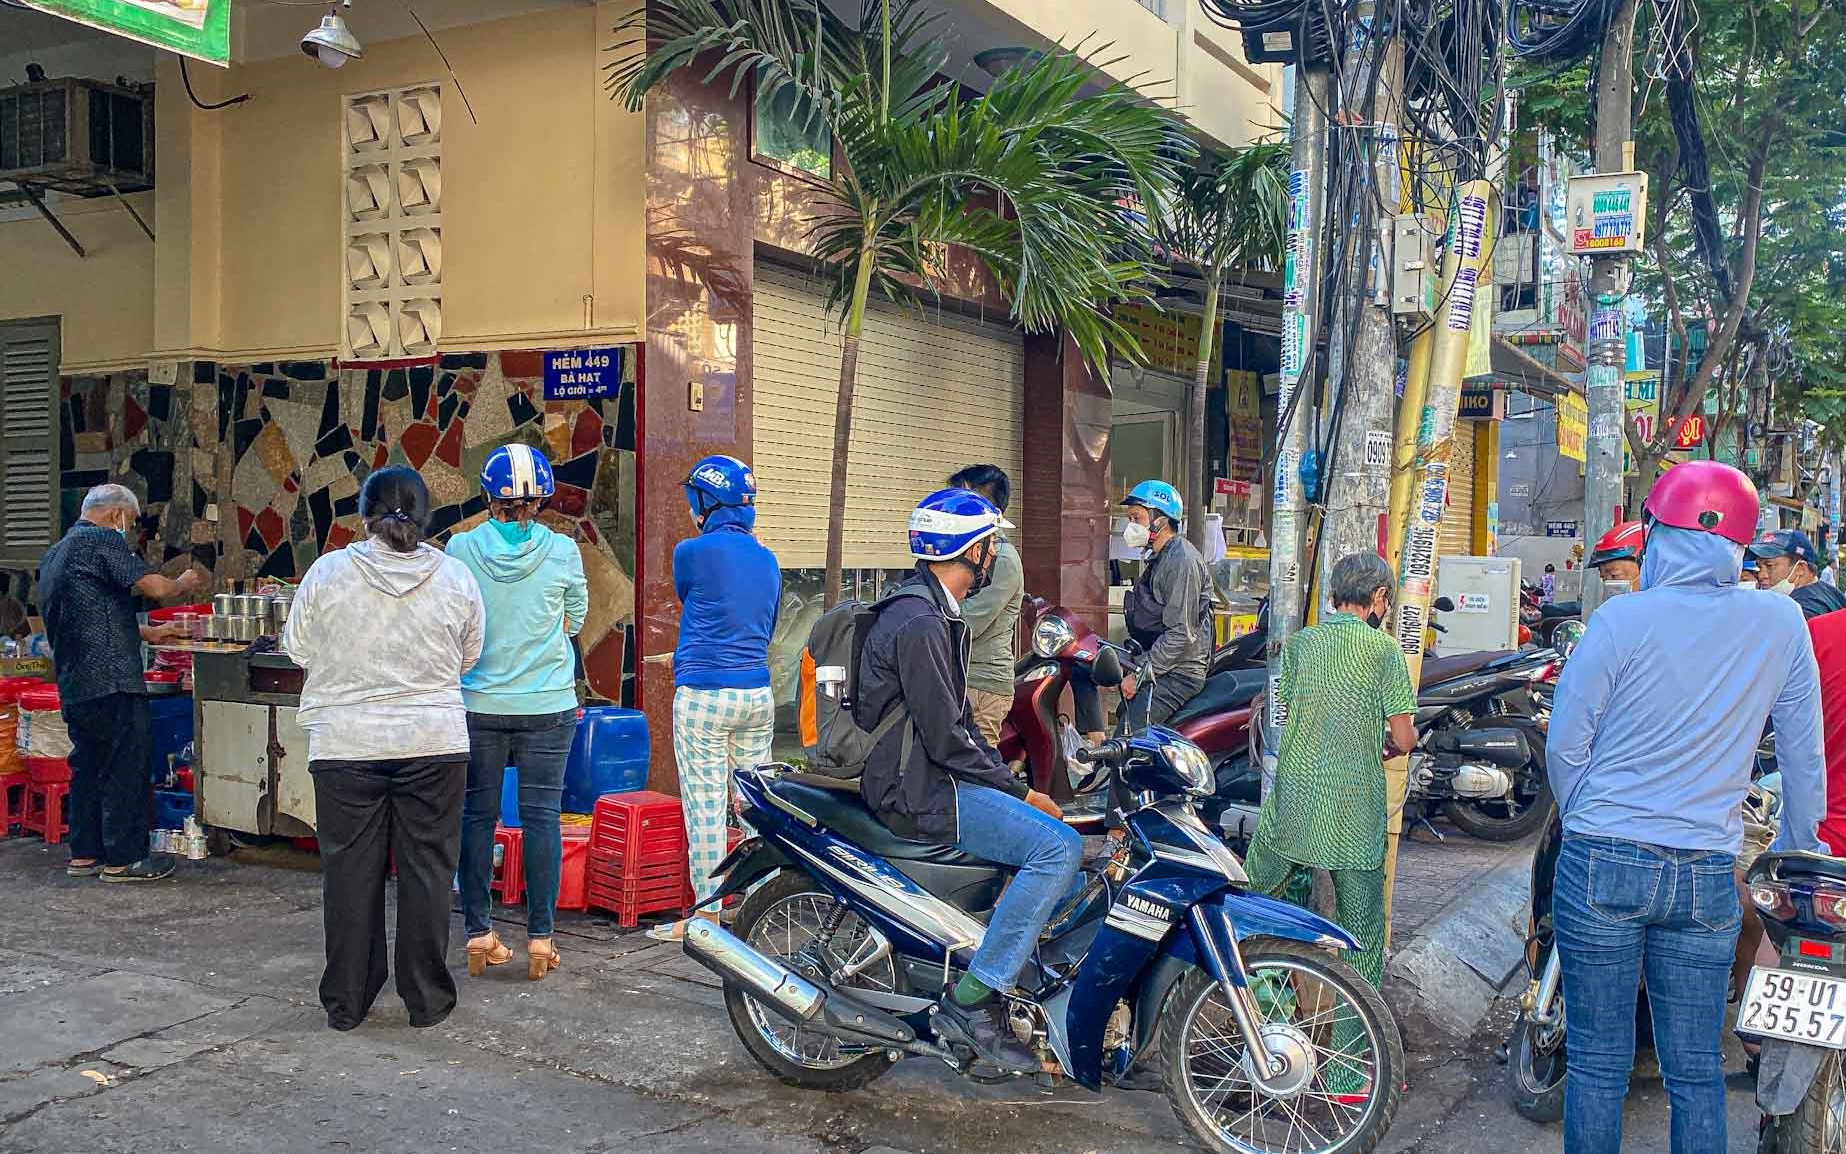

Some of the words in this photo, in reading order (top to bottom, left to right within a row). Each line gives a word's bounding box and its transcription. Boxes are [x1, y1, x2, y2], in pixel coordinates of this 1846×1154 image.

[552, 353, 582, 369] HẺM
[585, 355, 610, 368] 449
[578, 372, 601, 385] HẠT
[1127, 894, 1171, 921] YAMAHA
[1792, 961, 1830, 972] HONDA
[1744, 1001, 1845, 1041] 255.57
